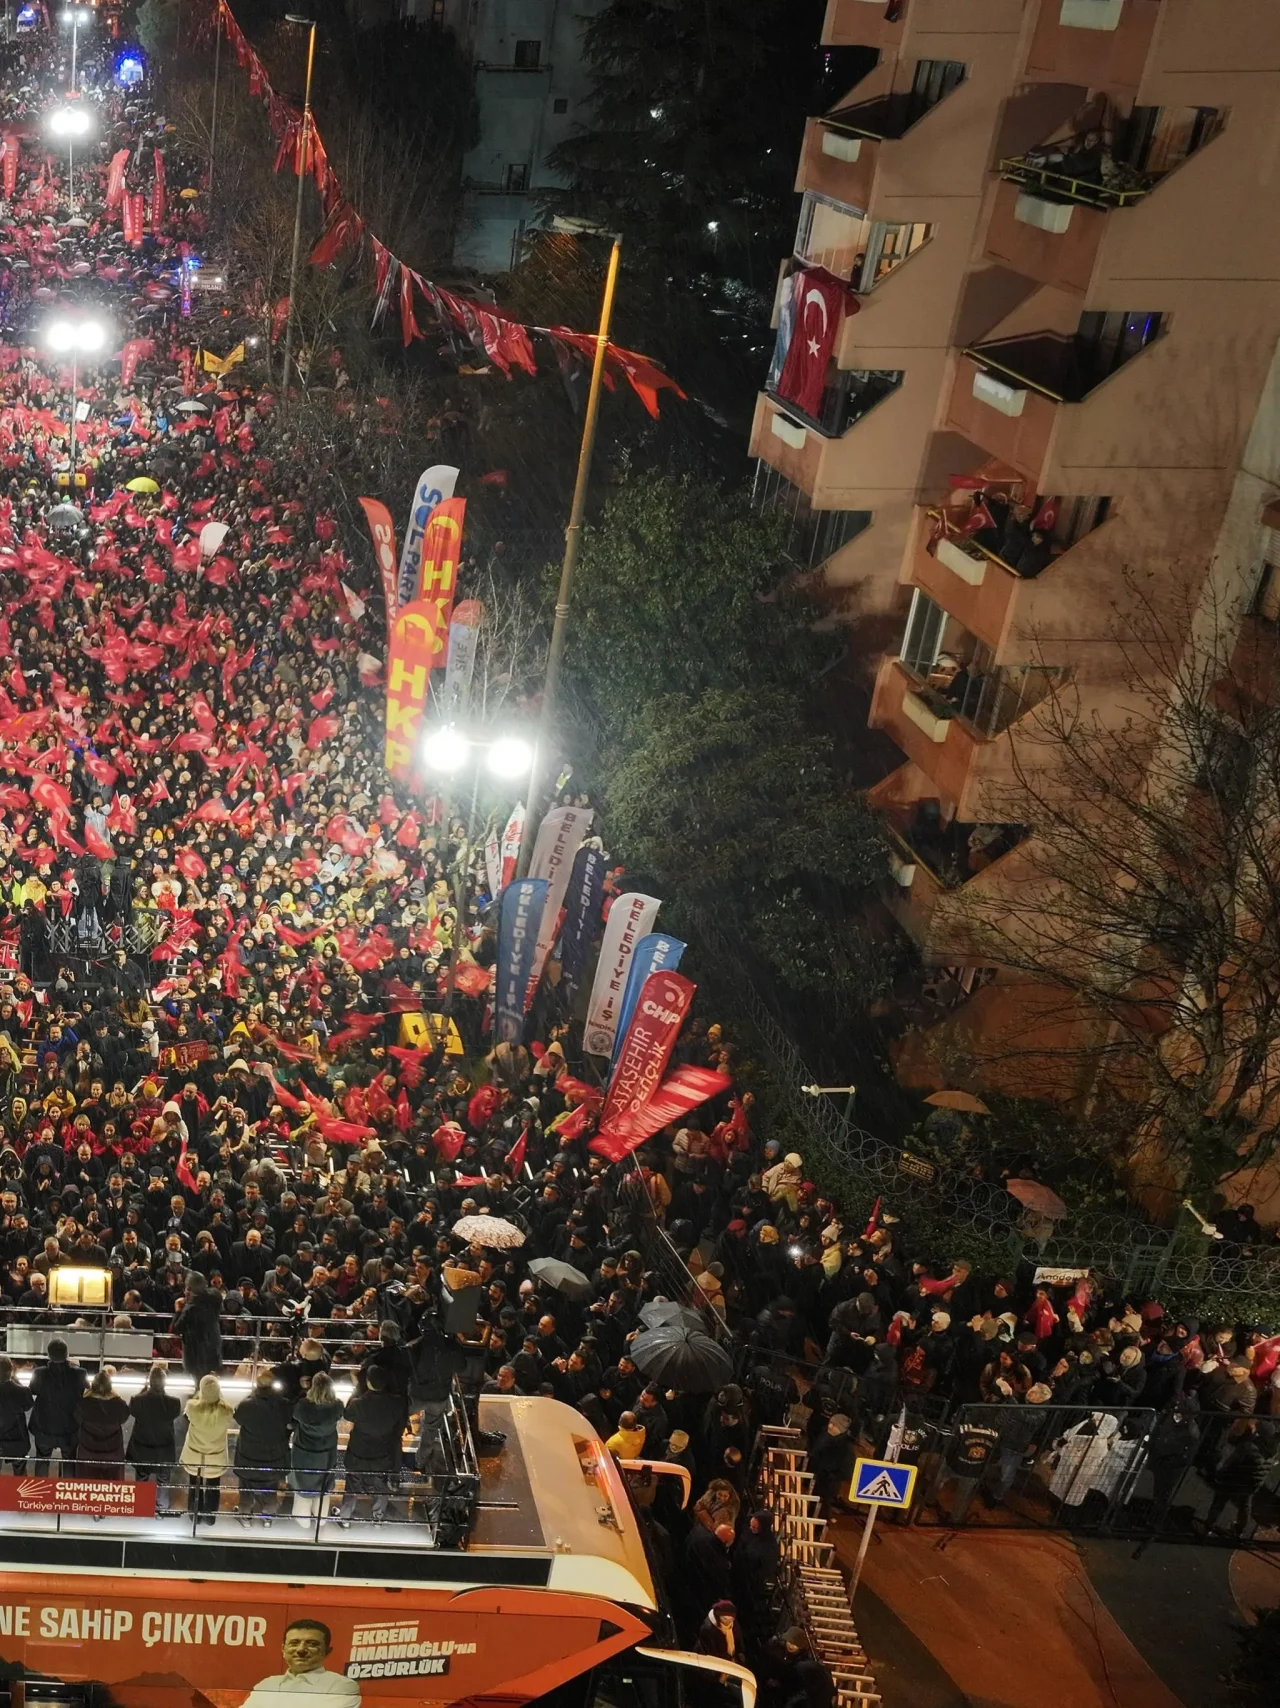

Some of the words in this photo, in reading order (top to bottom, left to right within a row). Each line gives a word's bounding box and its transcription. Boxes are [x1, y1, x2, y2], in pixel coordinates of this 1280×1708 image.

[408, 484, 443, 546] SOL
[398, 551, 424, 609] PART
[384, 658, 427, 770] HKP
[609, 898, 646, 992] BELEDİYE
[641, 1000, 681, 1025] CHP
[611, 1027, 652, 1112] ATAŞEHİR
[630, 1041, 667, 1113] GENÇLİK
[55, 1482, 136, 1494] CUMHURİYET
[55, 1491, 87, 1501] HALK
[89, 1493, 136, 1503] PARTİSİ
[17, 1500, 70, 1511] Türkiye'nin
[72, 1502, 102, 1513] Birinci
[104, 1504, 135, 1514] Partisi
[141, 1611, 268, 1648] ÇIKIYOR
[351, 1627, 419, 1646] EKREM
[349, 1640, 477, 1662] İMAMOĞLU'NA
[346, 1658, 446, 1679] ÖZGÜRLÜK
